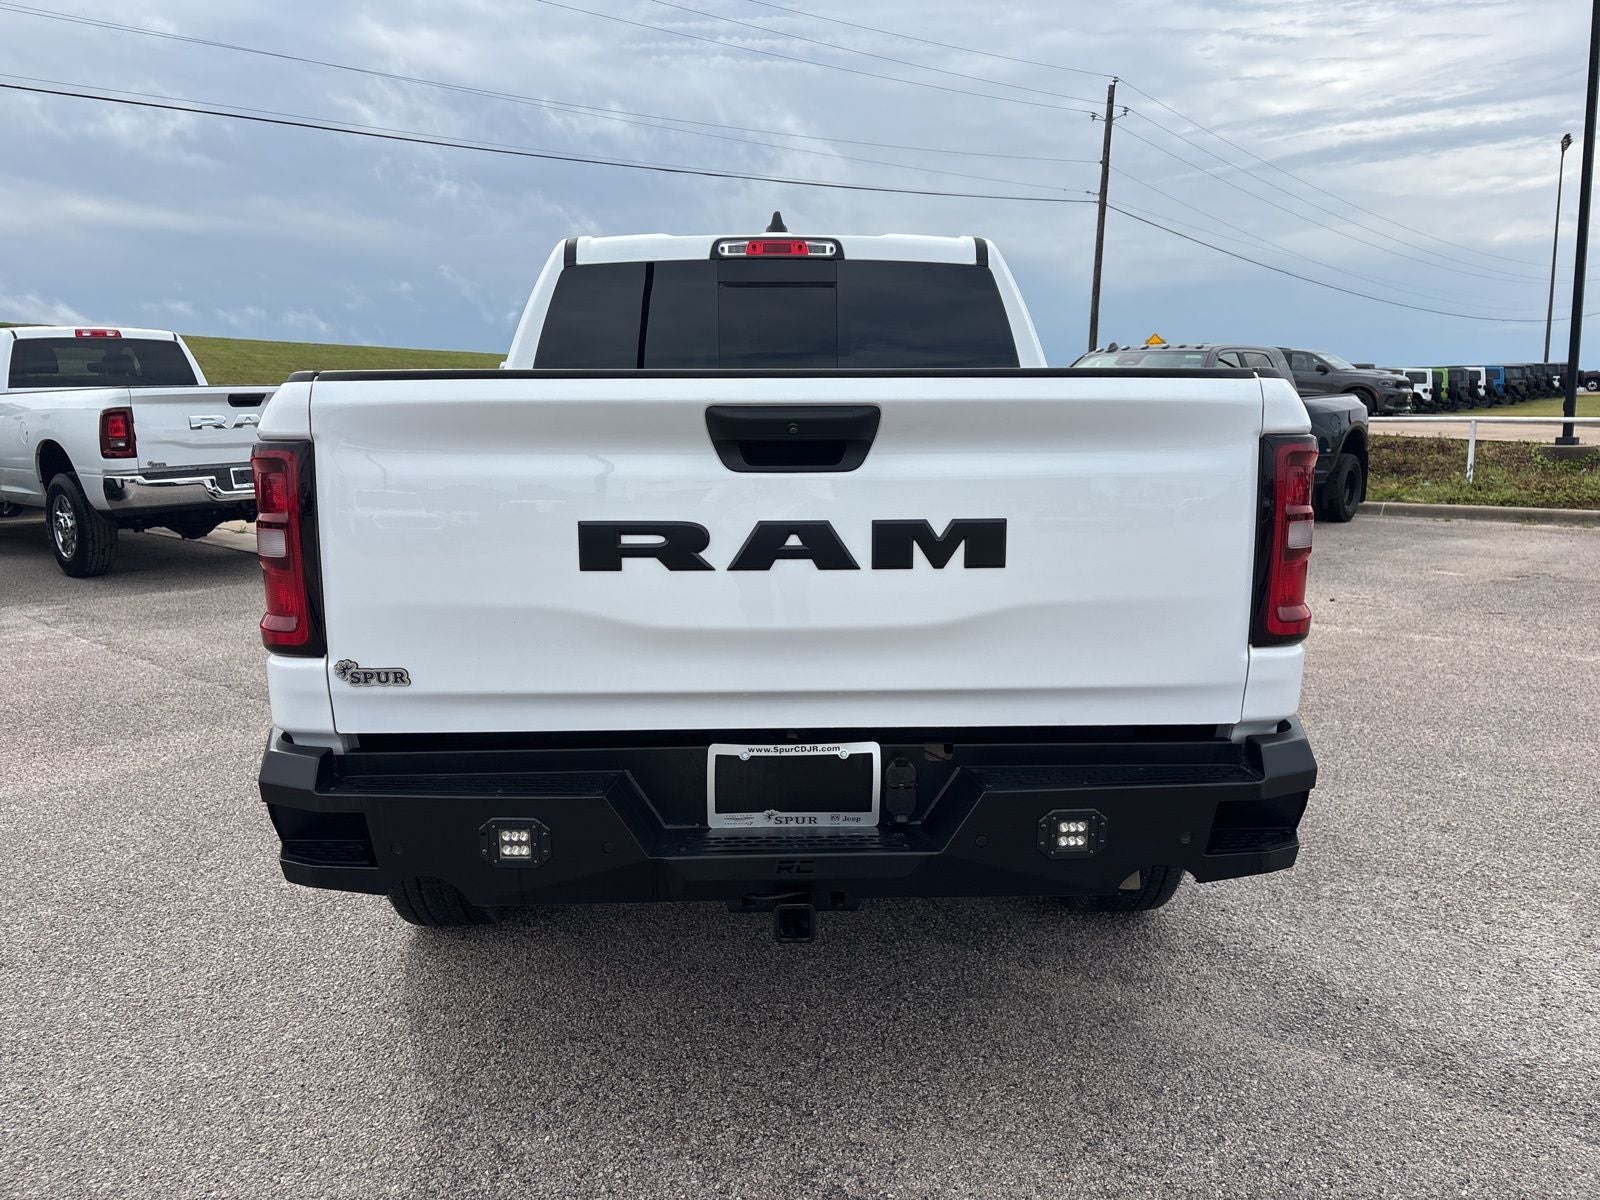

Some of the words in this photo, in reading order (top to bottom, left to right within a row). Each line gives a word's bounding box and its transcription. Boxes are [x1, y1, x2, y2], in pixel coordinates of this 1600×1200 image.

[188, 413, 261, 430] RA
[577, 517, 1008, 572] RAM
[349, 670, 408, 685] SPUR
[747, 744, 841, 755] www.SpurCDJR.com
[774, 815, 818, 825] SPUR
[842, 815, 861, 823] Jeep
[776, 859, 816, 875] RC
